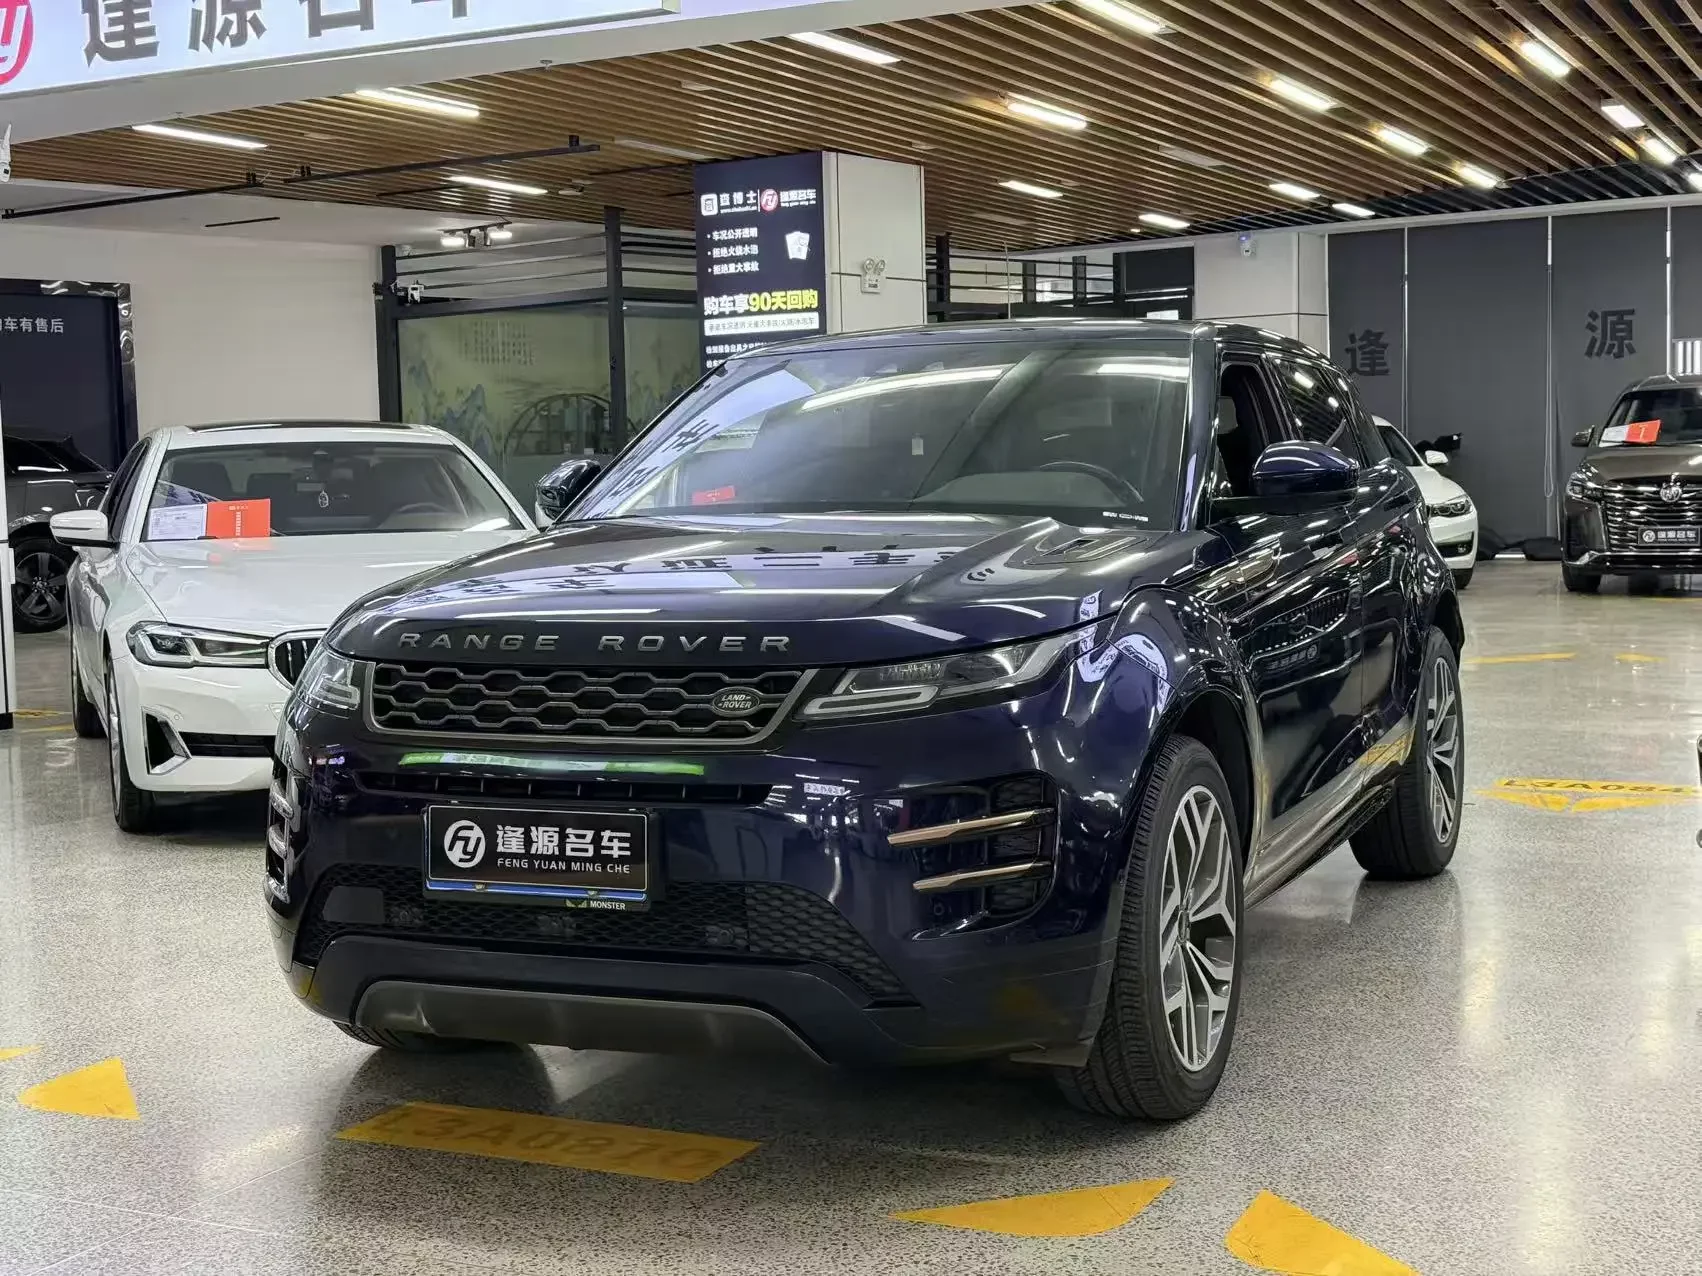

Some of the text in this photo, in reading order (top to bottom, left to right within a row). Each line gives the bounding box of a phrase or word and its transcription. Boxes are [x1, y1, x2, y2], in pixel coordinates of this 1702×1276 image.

[704, 289, 819, 316] 购车享90天回购
[0, 316, 65, 334] 车有售后
[1345, 308, 1637, 377] 逢 源
[399, 632, 791, 652] RANGE ROVER
[496, 824, 632, 859] 逢源名车
[497, 858, 630, 874] FENG YUAN MING CHE
[589, 900, 626, 911] MONSTER
